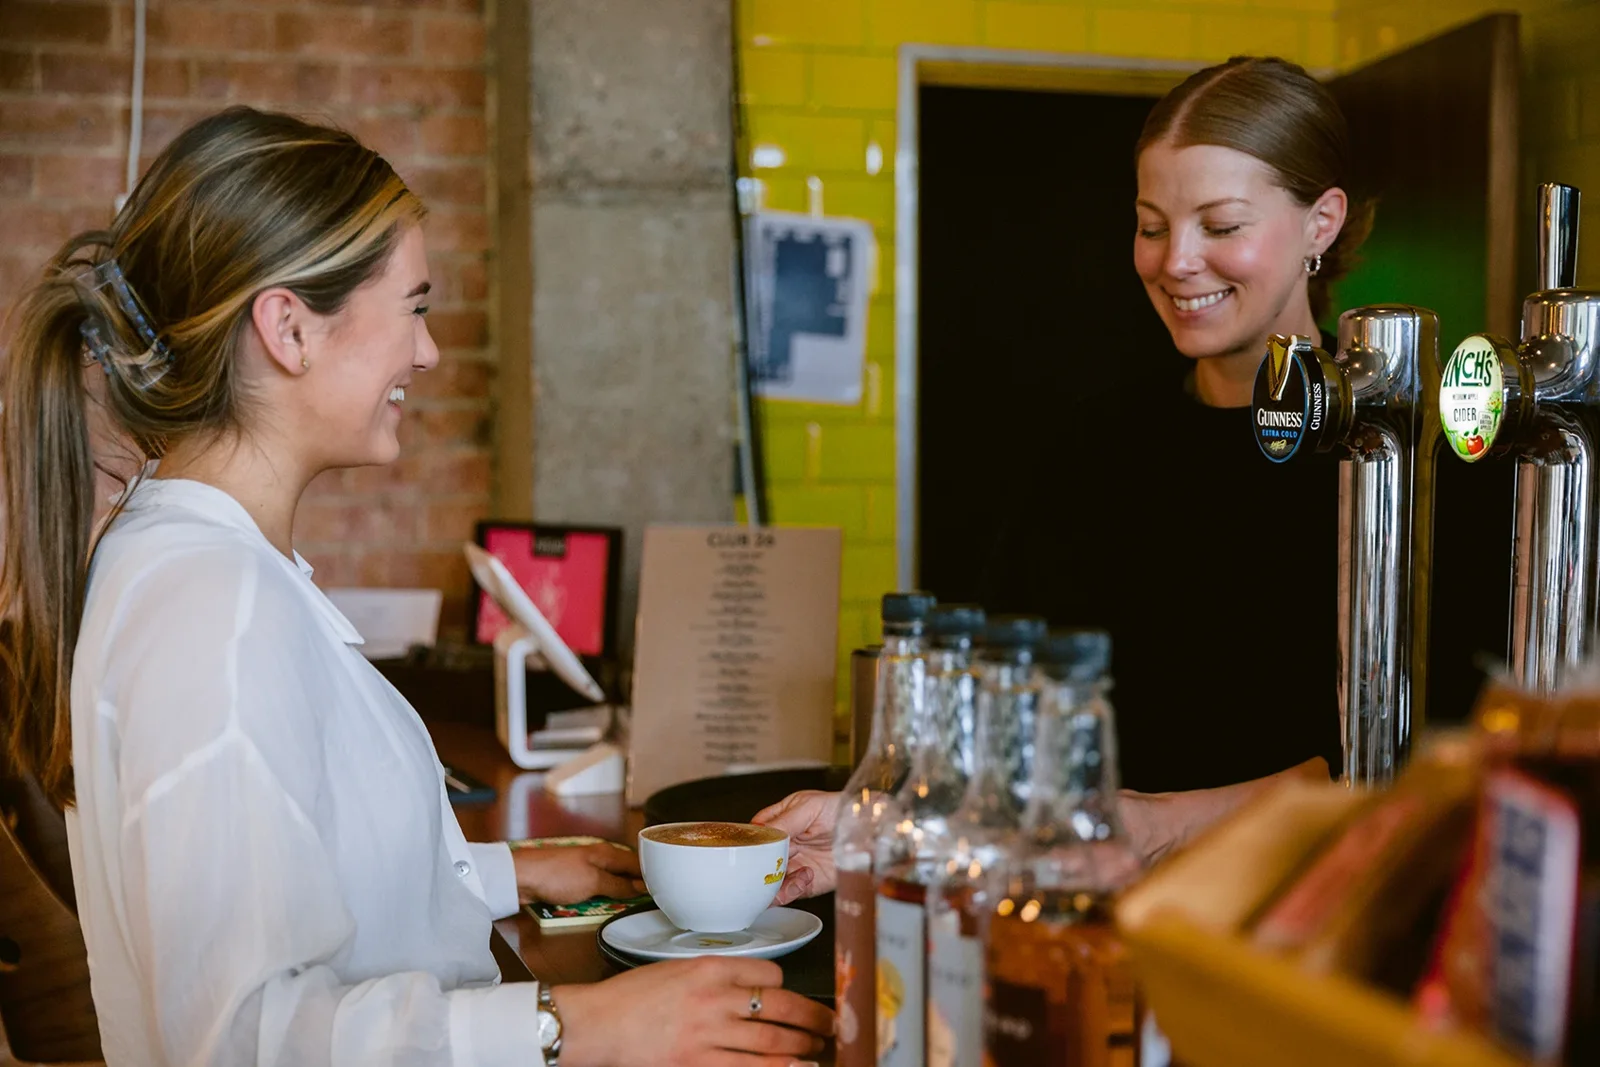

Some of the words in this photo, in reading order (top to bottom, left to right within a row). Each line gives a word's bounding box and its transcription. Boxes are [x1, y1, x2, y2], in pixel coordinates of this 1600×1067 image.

[1310, 382, 1322, 431] GUINNESS
[1453, 407, 1477, 422] CIDER
[1257, 408, 1303, 428] GUINNESS
[1262, 429, 1280, 437] EXTRA
[1280, 430, 1298, 438] COLD
